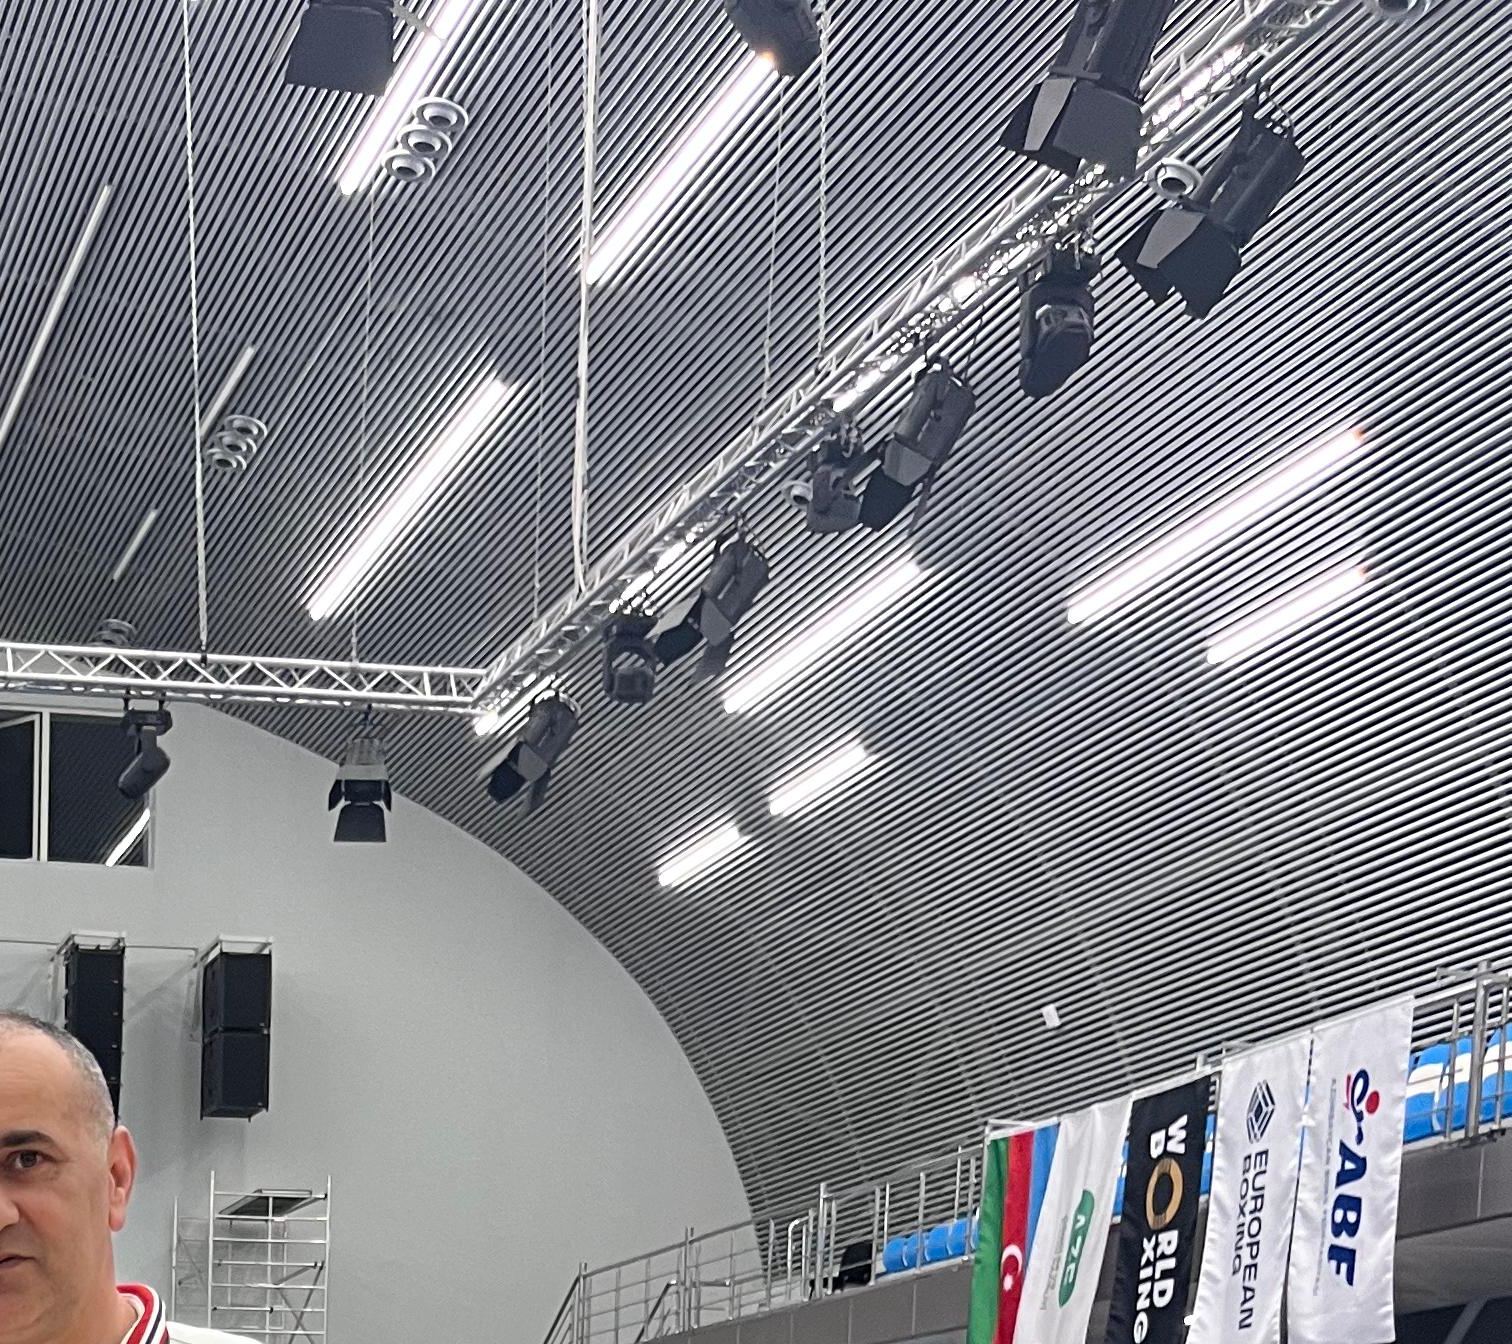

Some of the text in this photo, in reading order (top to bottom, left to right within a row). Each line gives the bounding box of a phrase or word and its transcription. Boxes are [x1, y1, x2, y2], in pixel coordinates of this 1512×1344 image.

[1148, 1114, 1189, 1309] WORLD
[1232, 1154, 1252, 1276] BOXING
[1238, 1148, 1269, 1331] EUROPEAN
[1327, 1139, 1367, 1287] ABF
